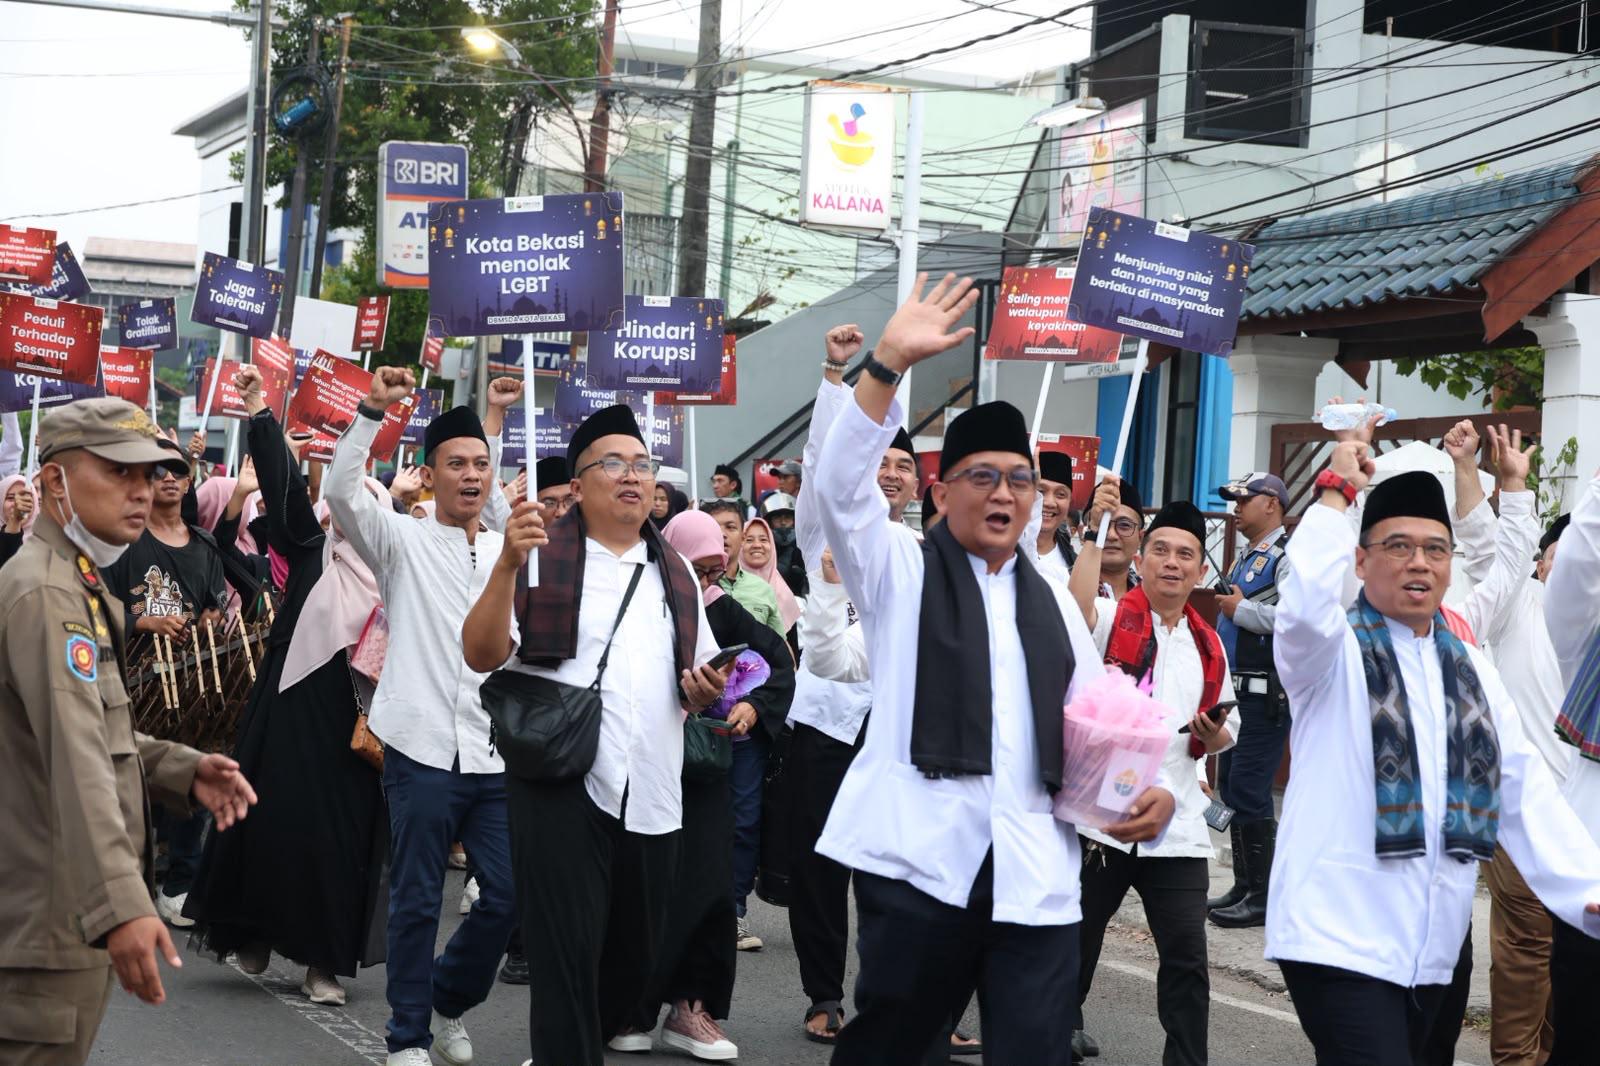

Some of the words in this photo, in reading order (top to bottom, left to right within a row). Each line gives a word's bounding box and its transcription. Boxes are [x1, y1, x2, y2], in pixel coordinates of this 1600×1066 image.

[420, 161, 459, 185] BRI
[813, 193, 884, 213] KALANA
[399, 211, 429, 229] AT
[466, 237, 513, 254] Kota
[517, 230, 585, 251] Bekasi
[480, 254, 571, 274] menolak
[1114, 252, 1186, 280] Menjunjung
[1186, 270, 1214, 286] nilai
[32, 271, 69, 295] orupsi
[224, 279, 256, 299] Jaga
[501, 276, 550, 294] LGBT
[1111, 267, 1135, 284] dan
[1136, 275, 1177, 292] norma
[1178, 284, 1210, 302] yang
[209, 289, 266, 315] Toleransi
[1007, 293, 1041, 306] Saling
[1089, 276, 1136, 297] berlaku
[1137, 286, 1151, 300] di
[1151, 291, 1225, 318] masyarakat
[24, 311, 65, 329] Peduli
[135, 314, 160, 327] Tolak
[1008, 306, 1064, 320] walaupun
[125, 320, 171, 340] Gratifikasi
[616, 319, 696, 341] Hindari
[1028, 320, 1087, 333] keyakinan
[11, 325, 76, 349] Terhadap
[15, 342, 68, 361] Sesama
[614, 341, 696, 366] Korupsi
[311, 375, 331, 390] Tahun
[331, 385, 346, 397] Baru
[331, 377, 355, 394] Dengan
[317, 395, 330, 405] dan
